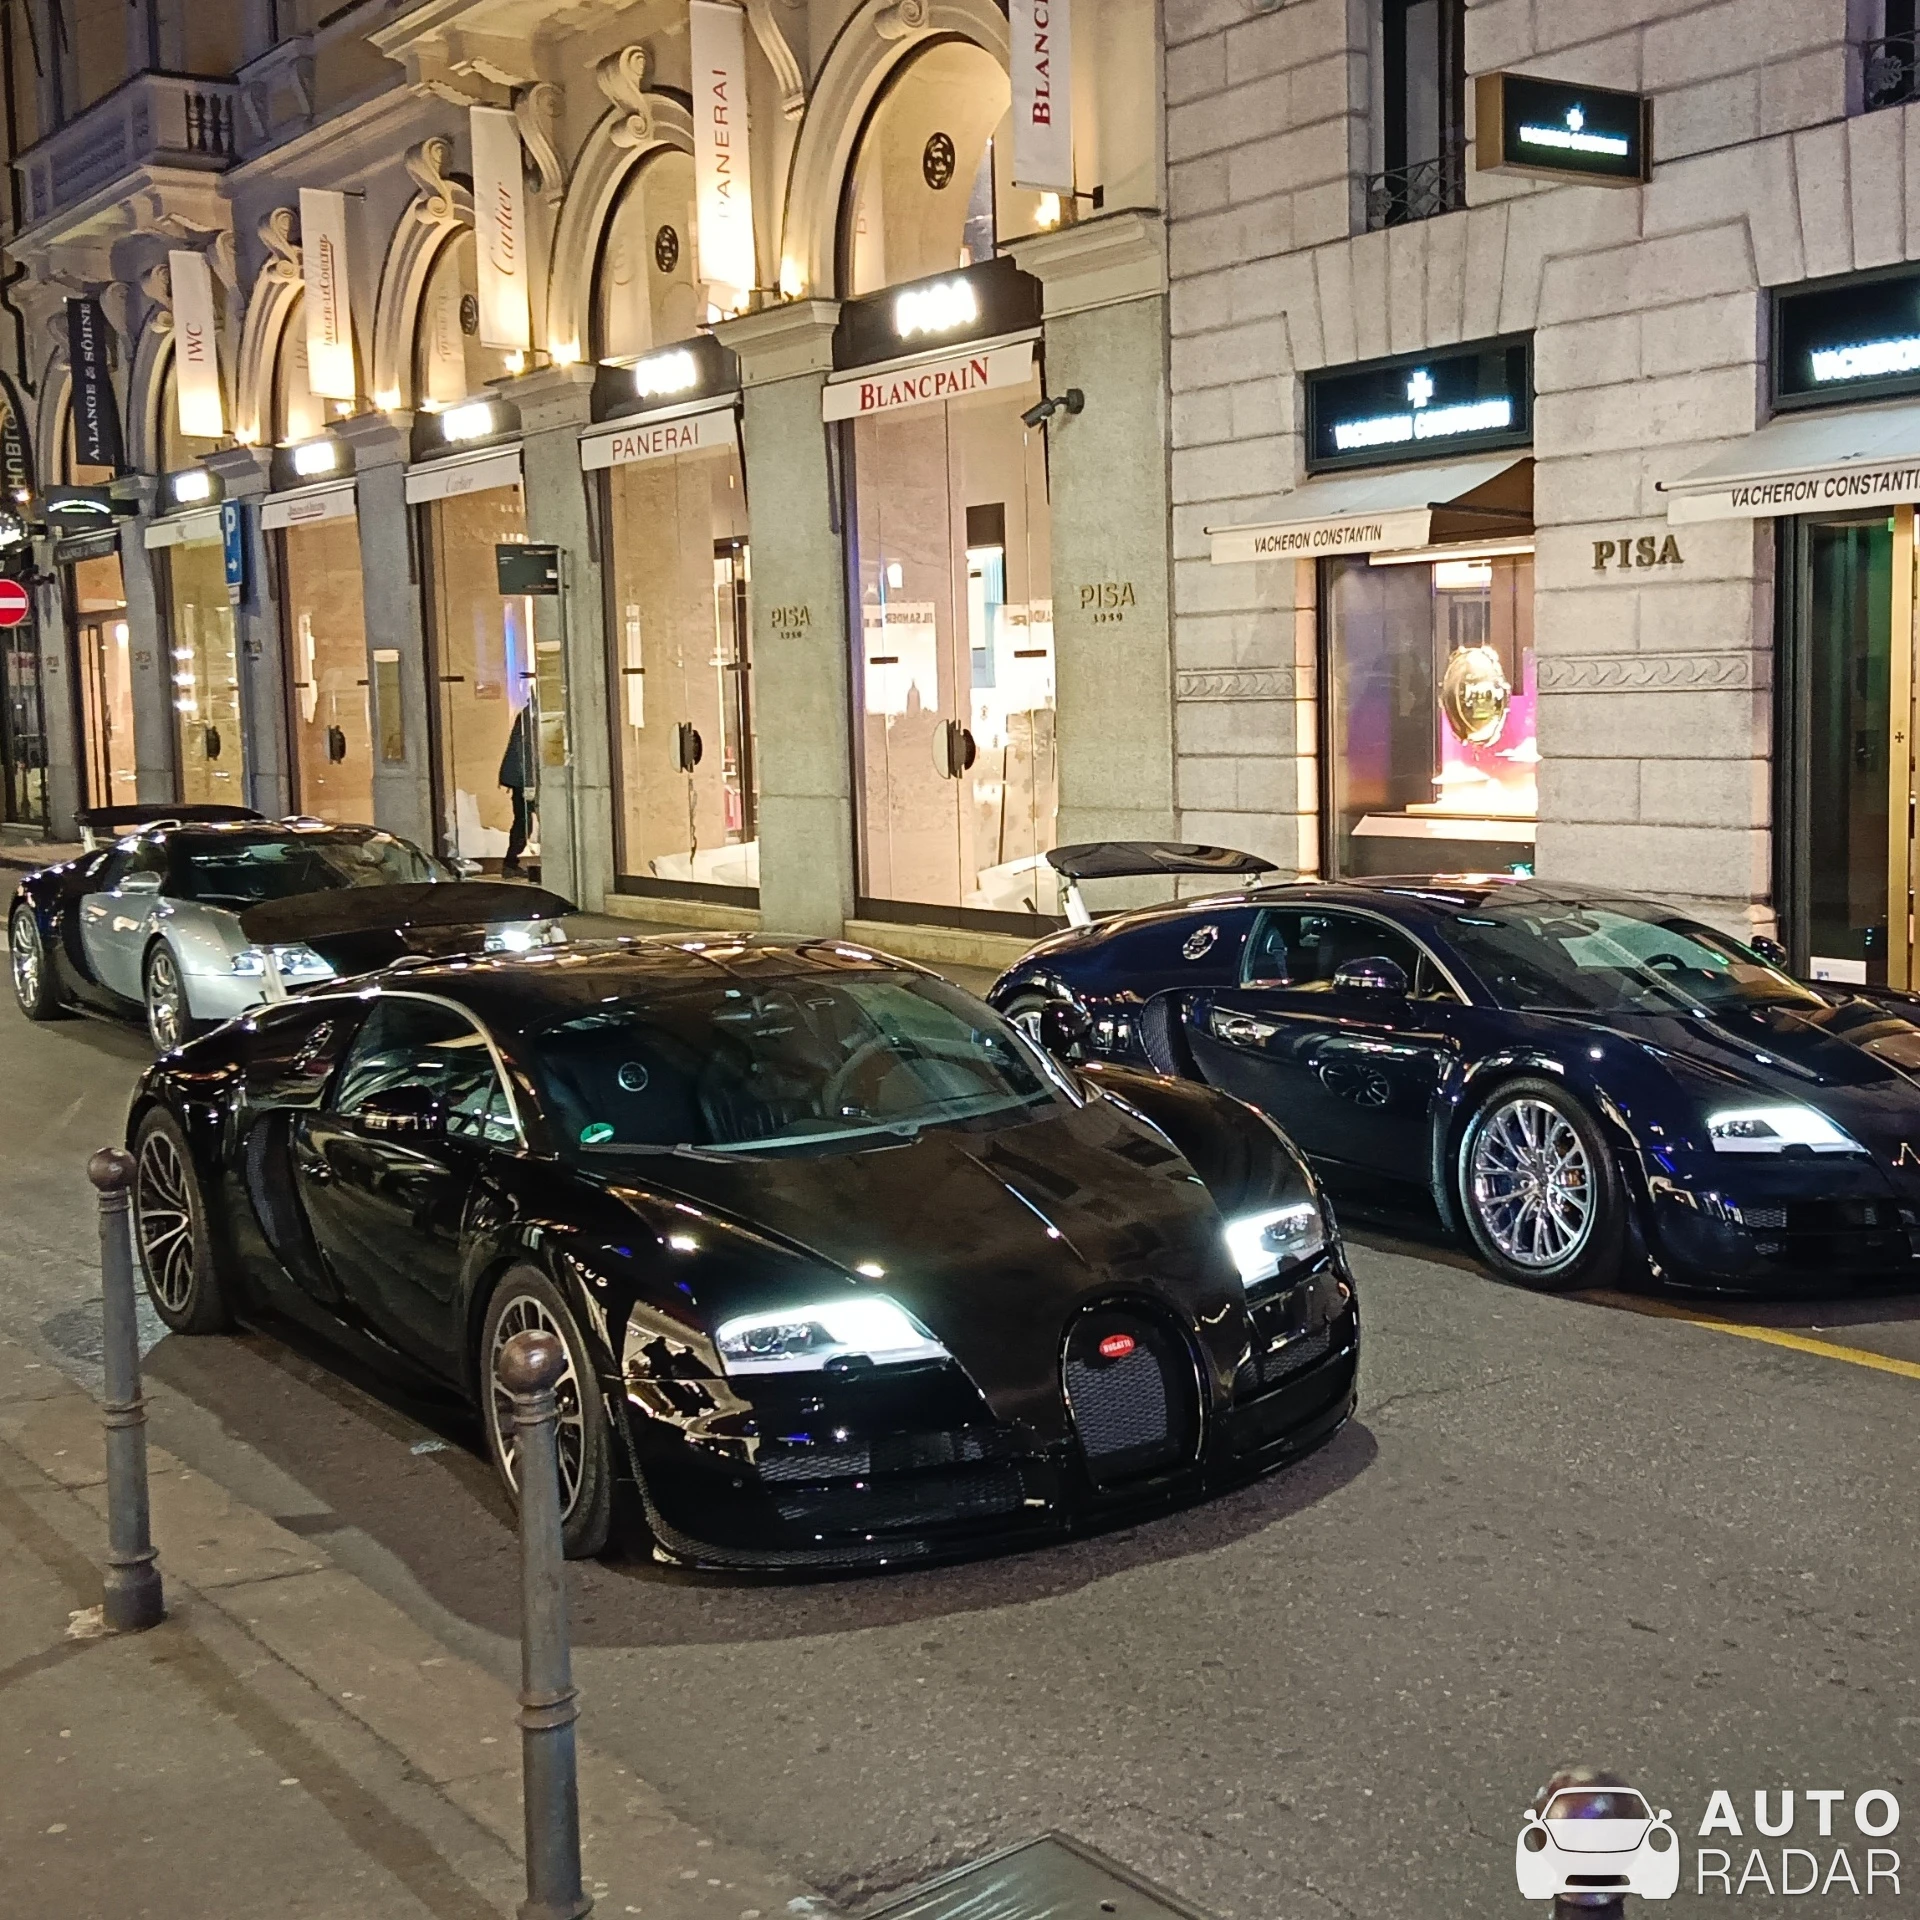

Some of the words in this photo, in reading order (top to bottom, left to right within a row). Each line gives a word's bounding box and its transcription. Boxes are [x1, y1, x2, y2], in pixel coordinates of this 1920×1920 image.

[1032, 0, 1051, 127] BLANC
[712, 70, 731, 218] PANERAI
[489, 182, 515, 276] Cartier
[186, 322, 204, 362] IWC
[859, 357, 989, 411] BLANCPAIN
[612, 422, 699, 461] PANERAI
[1731, 480, 1820, 508] VACHERON
[1824, 468, 1920, 498] CONSTANTI
[224, 506, 236, 546] P
[1254, 532, 1311, 553] VACHERON
[1313, 524, 1383, 547] CONSTANTIN
[1591, 534, 1685, 571] PISA
[1080, 582, 1136, 609] PISA
[771, 605, 812, 628] PISA
